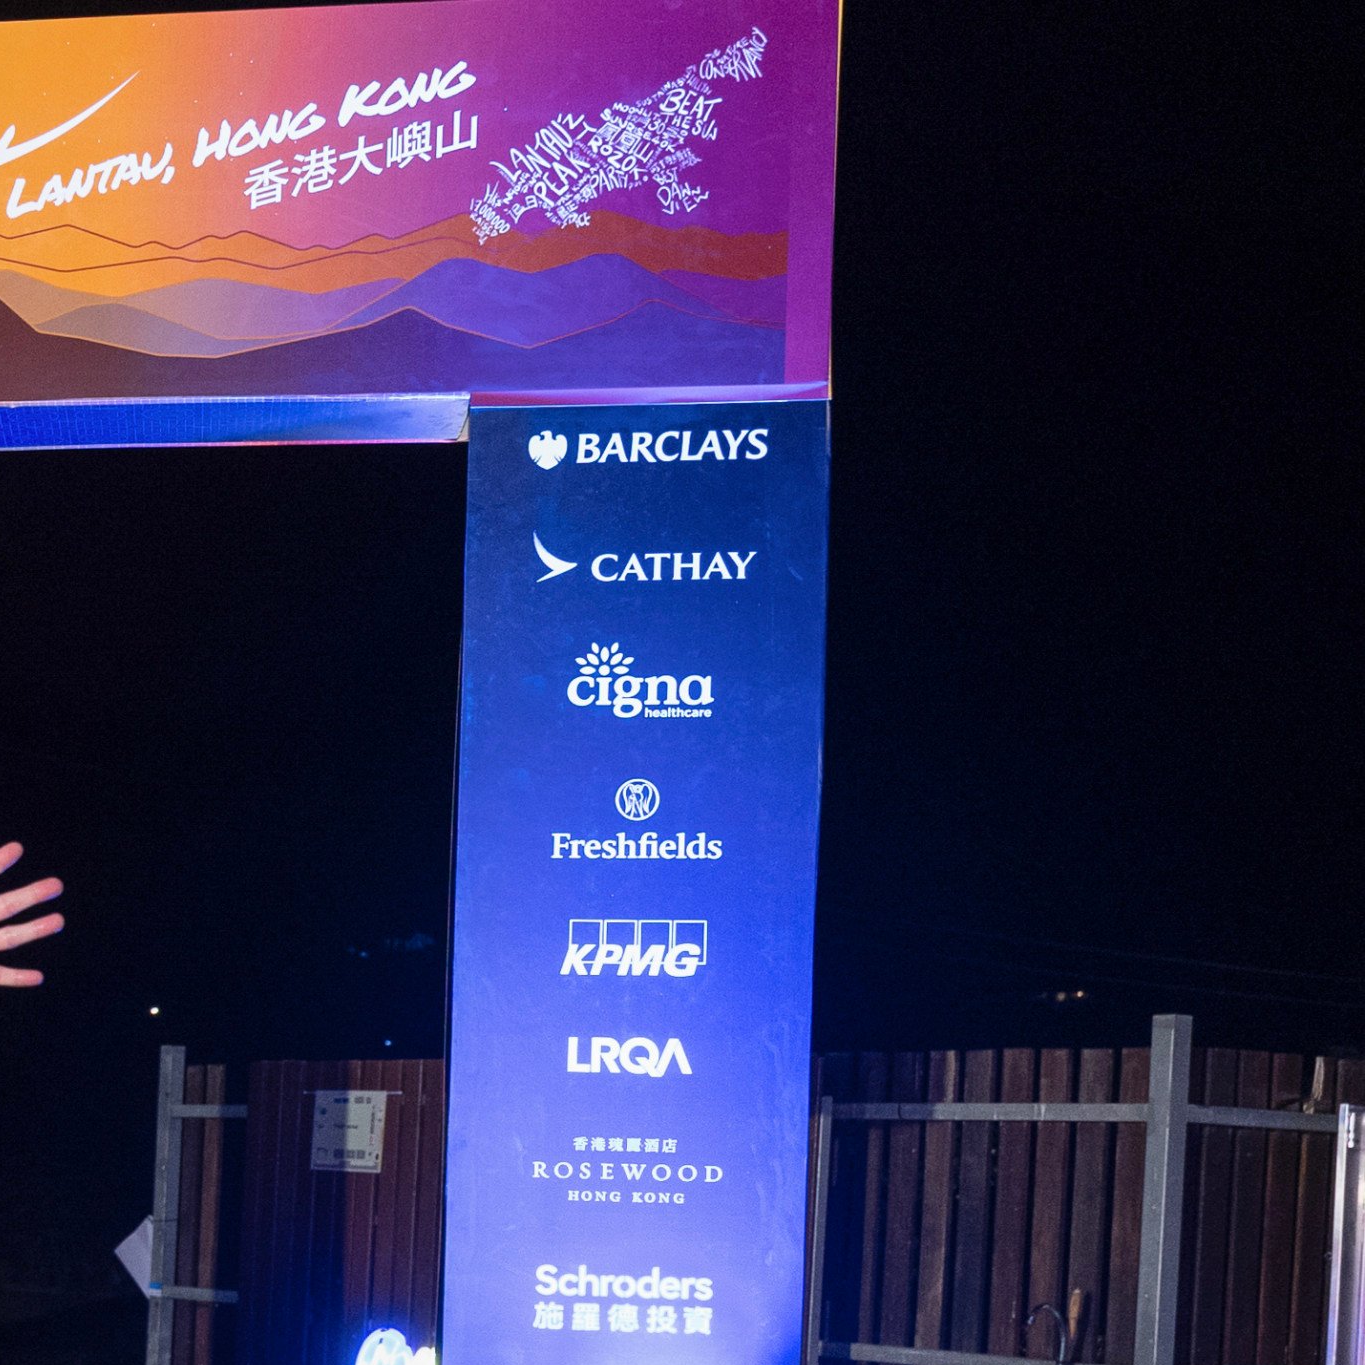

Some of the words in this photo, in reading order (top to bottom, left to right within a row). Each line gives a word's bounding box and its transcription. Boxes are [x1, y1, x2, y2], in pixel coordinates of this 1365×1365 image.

[658, 88, 723, 122] BEAT
[660, 111, 693, 130] THE
[6, 142, 175, 219] LANTAU,
[192, 102, 326, 168] HONG
[337, 60, 478, 128] KONG
[243, 109, 479, 210] 香港大嶼山
[488, 119, 574, 183] LANTAU
[533, 149, 592, 208] PEAK
[576, 428, 769, 463] BARCLAYS
[591, 551, 757, 582] CATHAY
[567, 672, 714, 718] cigna
[644, 705, 712, 719] healthcare
[551, 831, 723, 860] Freshfields
[559, 943, 702, 977] KPMG
[567, 1036, 693, 1078] LRQA
[532, 1161, 724, 1183] ROSEWOOD
[567, 1190, 622, 1203] HONG
[631, 1192, 686, 1205] KONG
[535, 1264, 713, 1301] Schroders
[532, 1301, 714, 1336] 施羅德投資
